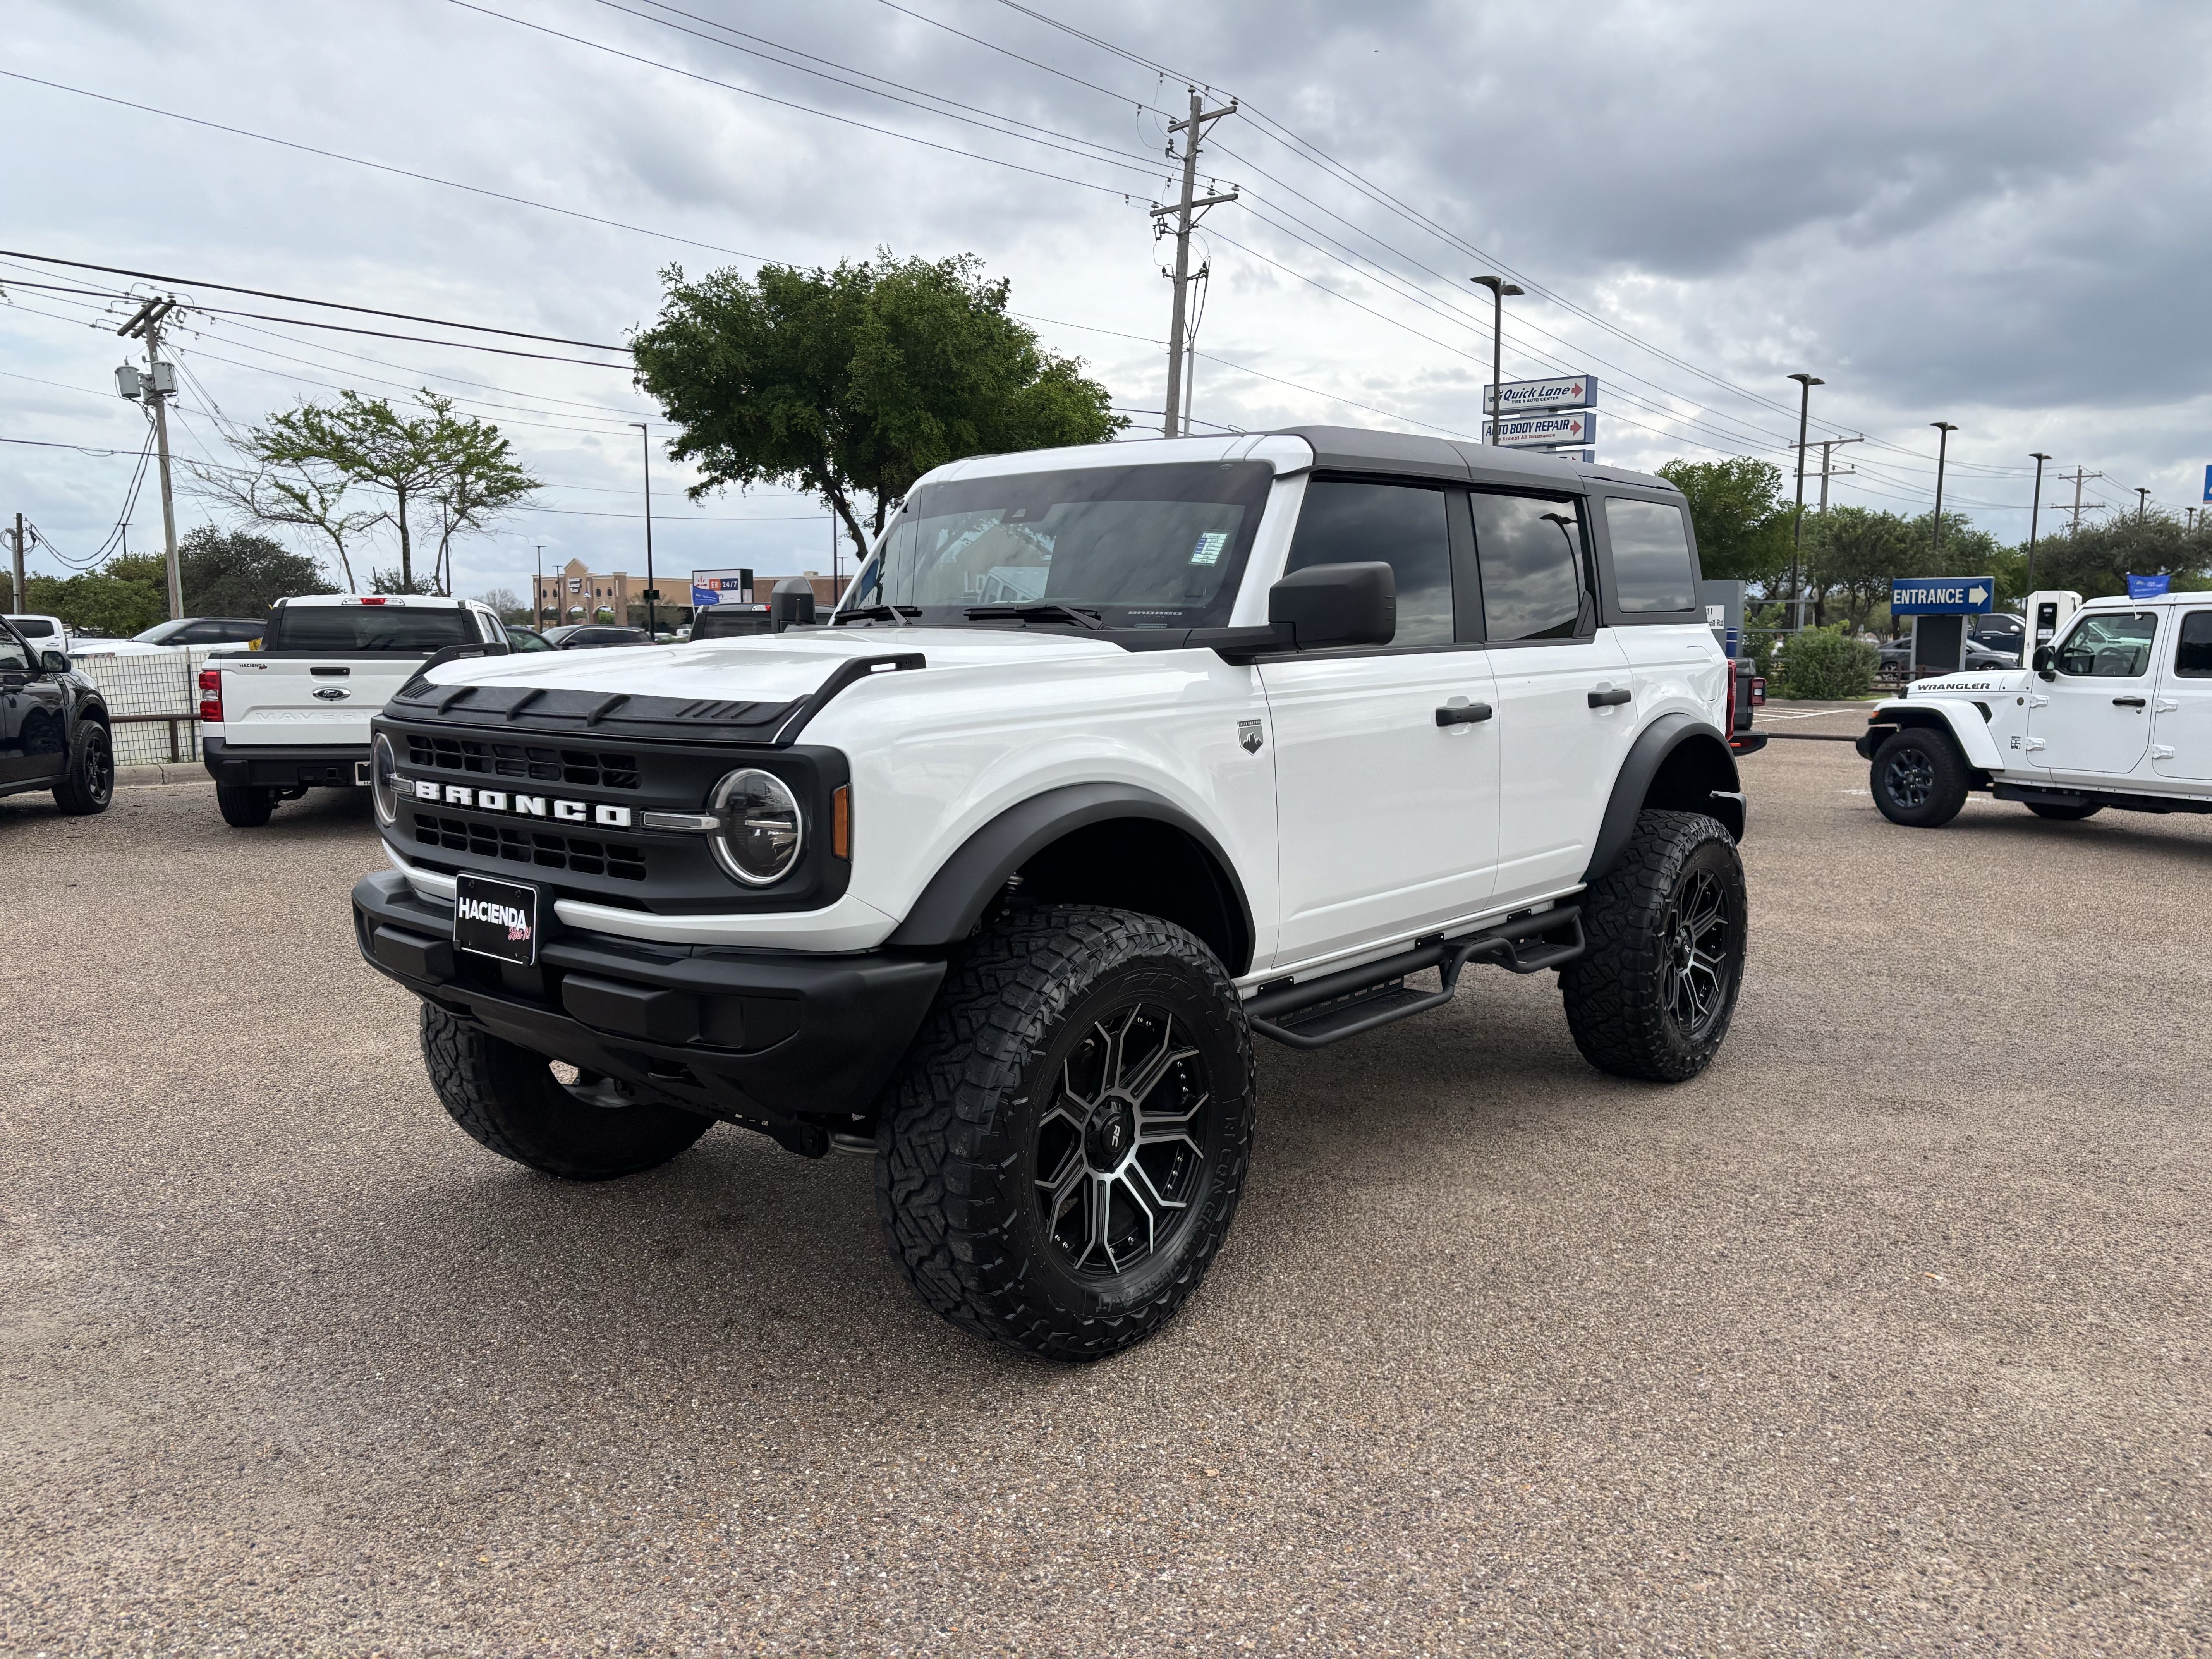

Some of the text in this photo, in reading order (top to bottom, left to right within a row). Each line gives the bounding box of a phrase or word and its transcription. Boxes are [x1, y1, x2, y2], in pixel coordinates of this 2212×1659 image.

[1504, 386, 1570, 401] Quick Lane
[1486, 419, 1570, 436] ATO BODY REPAIR
[1893, 588, 1964, 604] ENTRANCE
[416, 781, 631, 826] BRONCO
[459, 897, 526, 932] HACIENDA
[1111, 1125, 1120, 1147] RC
